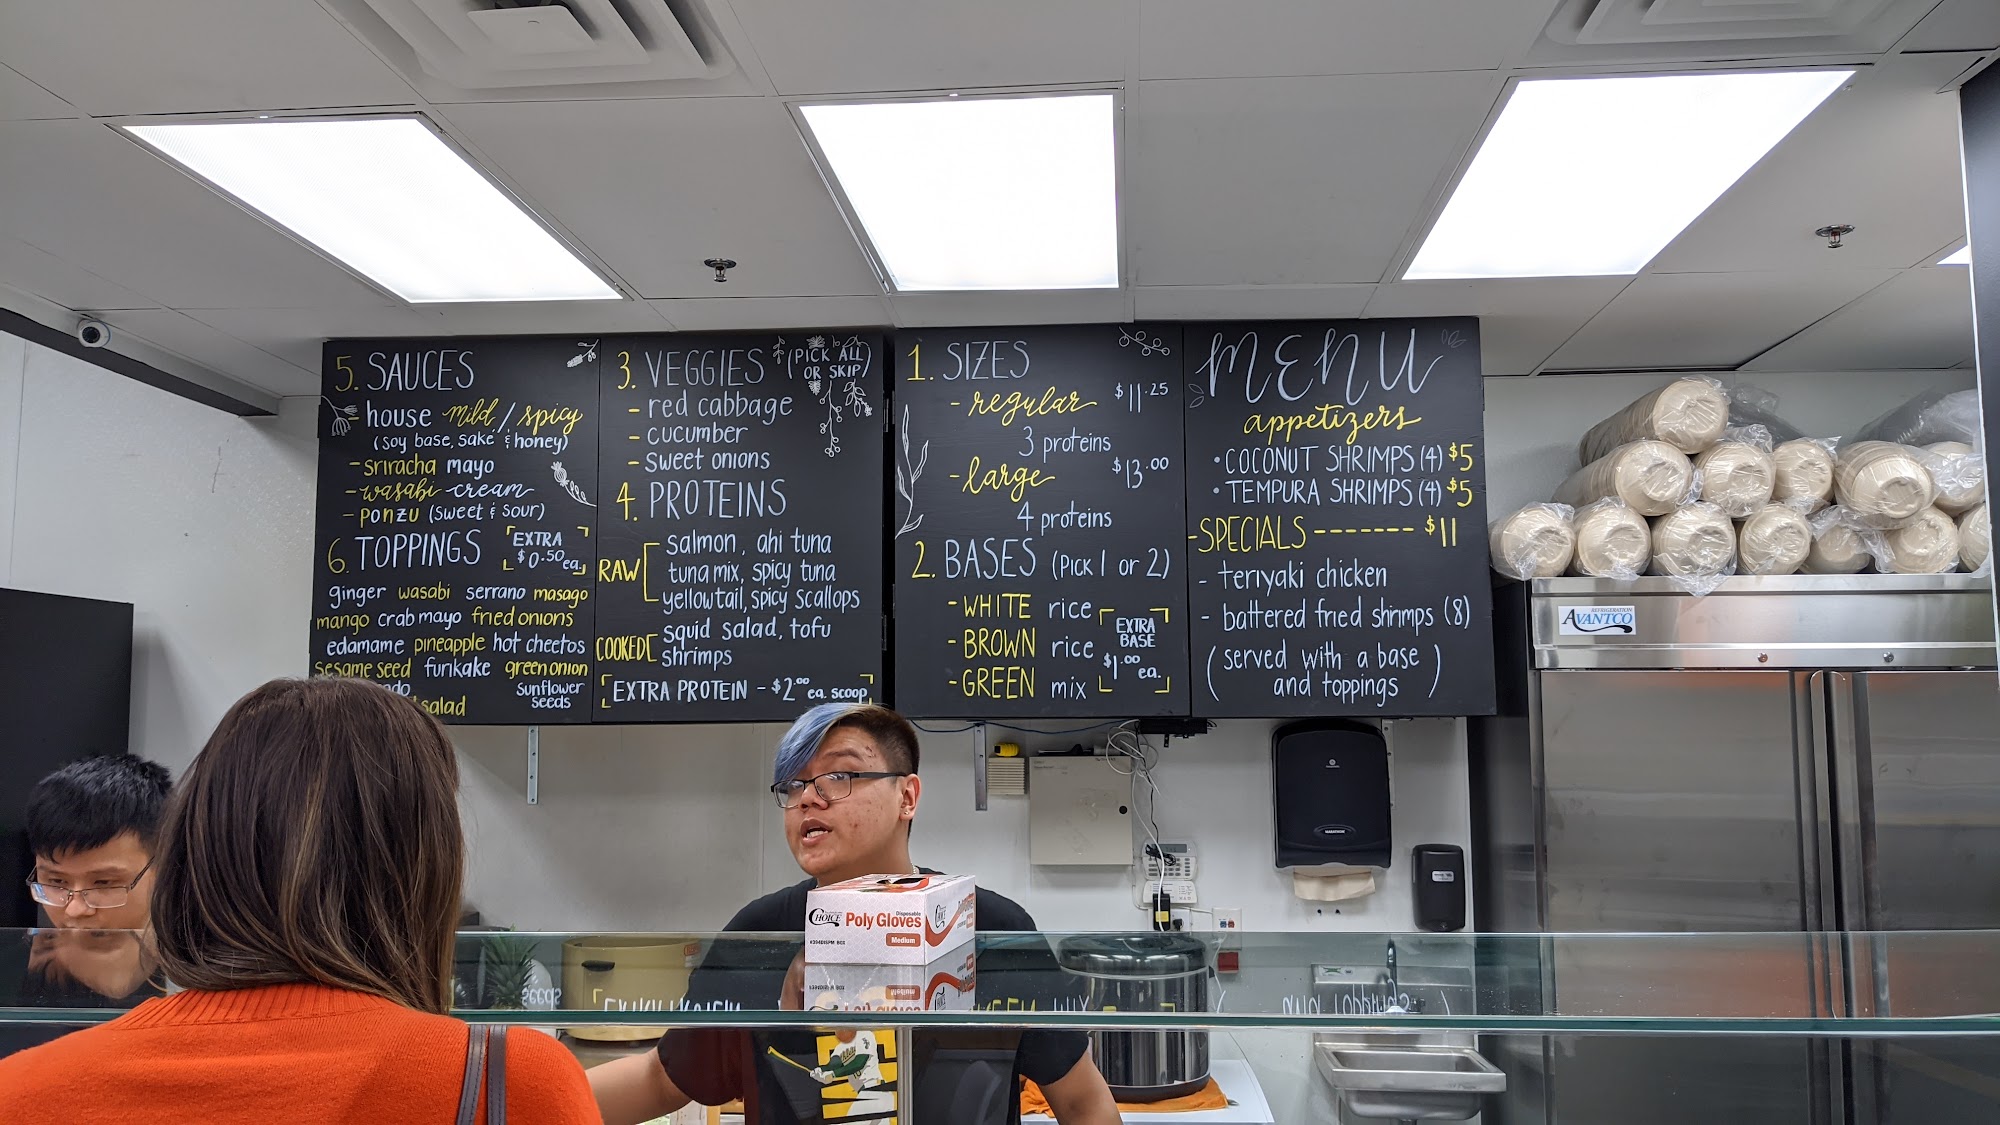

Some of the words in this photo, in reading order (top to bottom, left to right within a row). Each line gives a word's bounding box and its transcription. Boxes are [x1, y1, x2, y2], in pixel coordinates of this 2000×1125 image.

[616, 351, 637, 389] 3.
[644, 348, 765, 388] VEGGIES
[839, 347, 864, 362] ALL
[907, 343, 934, 381] 1.
[942, 340, 1030, 381] SIZES
[1195, 328, 1444, 406] MENU
[335, 355, 359, 392] 5.
[367, 350, 475, 391] SAUCES
[804, 366, 821, 380] OR
[366, 400, 432, 428] house
[442, 398, 499, 427] mild
[516, 402, 583, 436] spicy
[648, 390, 688, 418] red
[698, 391, 793, 425] cabbage
[968, 386, 1097, 426] regular
[1115, 382, 1169, 413] $11.25
[647, 422, 748, 445] cucumber
[1243, 403, 1422, 445] appetizers
[373, 437, 407, 454] (soy
[414, 432, 454, 449] base,
[514, 432, 569, 455] honey)
[1019, 426, 1034, 457] 3
[1043, 427, 1112, 463] proteins
[363, 453, 436, 476] sriracha
[446, 458, 495, 480] mayo
[645, 448, 704, 472] sweet
[711, 452, 770, 470] onions
[1225, 445, 1319, 475] COCONUT
[1325, 445, 1415, 475] SHRIMPS
[1420, 445, 1443, 473] (4)
[1448, 442, 1473, 471] $5
[359, 477, 442, 502] wasabi
[445, 481, 535, 499] cream
[963, 456, 1055, 502] large
[1112, 456, 1169, 489] $13.00
[1225, 478, 1320, 505] TEMPURA
[1330, 477, 1413, 506] SHRIMPS
[1418, 479, 1442, 507] (4)
[1446, 476, 1473, 507] $5
[616, 482, 638, 521] 4.
[650, 479, 787, 520] PROTEINS
[360, 507, 419, 528] ponzu
[428, 503, 484, 522] (sweet
[502, 503, 546, 521] sour)
[1017, 501, 1034, 531] 4
[1041, 500, 1112, 536] proteins
[512, 531, 563, 547] EXTRA
[666, 529, 746, 555] salmon,
[757, 528, 783, 554] ahi
[790, 527, 832, 554] tuna
[1198, 515, 1306, 552] SPECIALS
[1424, 515, 1456, 547] $11
[327, 537, 350, 574] 6.
[354, 529, 482, 571] TOPPINGS
[517, 549, 565, 569] $0.50
[562, 558, 582, 571] ea.
[911, 540, 936, 579] 2.
[945, 537, 1036, 579] BASES
[1101, 549, 1106, 576] 1
[1118, 558, 1140, 575] or
[1146, 548, 1170, 579] 2)
[598, 558, 641, 582] RAW
[668, 562, 709, 584] tuna
[713, 560, 744, 584] mix,
[752, 559, 791, 588] spicy
[800, 561, 836, 582] tuna
[1218, 560, 1304, 596] teriyaki
[1316, 558, 1387, 588] chicken
[328, 584, 387, 609] ginger
[398, 581, 451, 600] wasabi
[465, 584, 526, 601] serrano
[533, 588, 589, 609] masago
[662, 587, 747, 615] yellowtail,
[750, 587, 788, 615] spicy
[796, 587, 860, 613] scallops
[963, 593, 1031, 618] WHITE
[1049, 598, 1092, 619] rice
[316, 613, 370, 634] mango
[377, 607, 415, 627] crab
[418, 609, 462, 630] mayo
[471, 605, 515, 626] fried
[518, 608, 574, 626] onions
[1116, 617, 1155, 633] EXTRA
[1223, 599, 1306, 631] battered
[1315, 596, 1361, 628] fried
[1371, 596, 1434, 636] shrimps
[1444, 595, 1470, 629] (8)
[1562, 608, 1633, 630] AVANTCO
[326, 636, 405, 657] edamame
[414, 632, 486, 656] pineapple
[493, 631, 522, 653] hot
[525, 633, 586, 654] cheetos
[663, 618, 711, 650] squid
[721, 616, 783, 640] salad,
[790, 616, 831, 639] tofu
[963, 627, 1036, 658] BROWN
[1052, 636, 1094, 658] rice
[1119, 634, 1156, 648] BASE
[596, 636, 646, 662] COOKED
[661, 645, 733, 671] shrimps
[1302, 641, 1341, 670] with
[1357, 651, 1368, 668] a
[1378, 642, 1420, 669] base
[314, 660, 372, 678] sesame
[376, 658, 412, 679] seed
[424, 656, 491, 677] furikake
[505, 659, 547, 679] green
[549, 661, 588, 677] onion
[1103, 653, 1141, 679] $1.00
[1138, 666, 1162, 679] ea.
[516, 680, 585, 696] sunflower
[613, 680, 670, 702] EXTRA
[677, 679, 748, 701] PROTEIN
[771, 677, 810, 701] $2.00
[807, 687, 827, 700] ea.
[831, 687, 868, 705] scoop
[962, 666, 1035, 699] GREEN
[1051, 676, 1087, 699] mix
[1274, 671, 1311, 696] and
[421, 695, 466, 716] salad
[531, 695, 571, 709] seeds
[809, 908, 841, 927] CHOICE
[846, 912, 874, 930] Poly
[876, 912, 922, 928] Gloves
[891, 936, 916, 944] Medium
